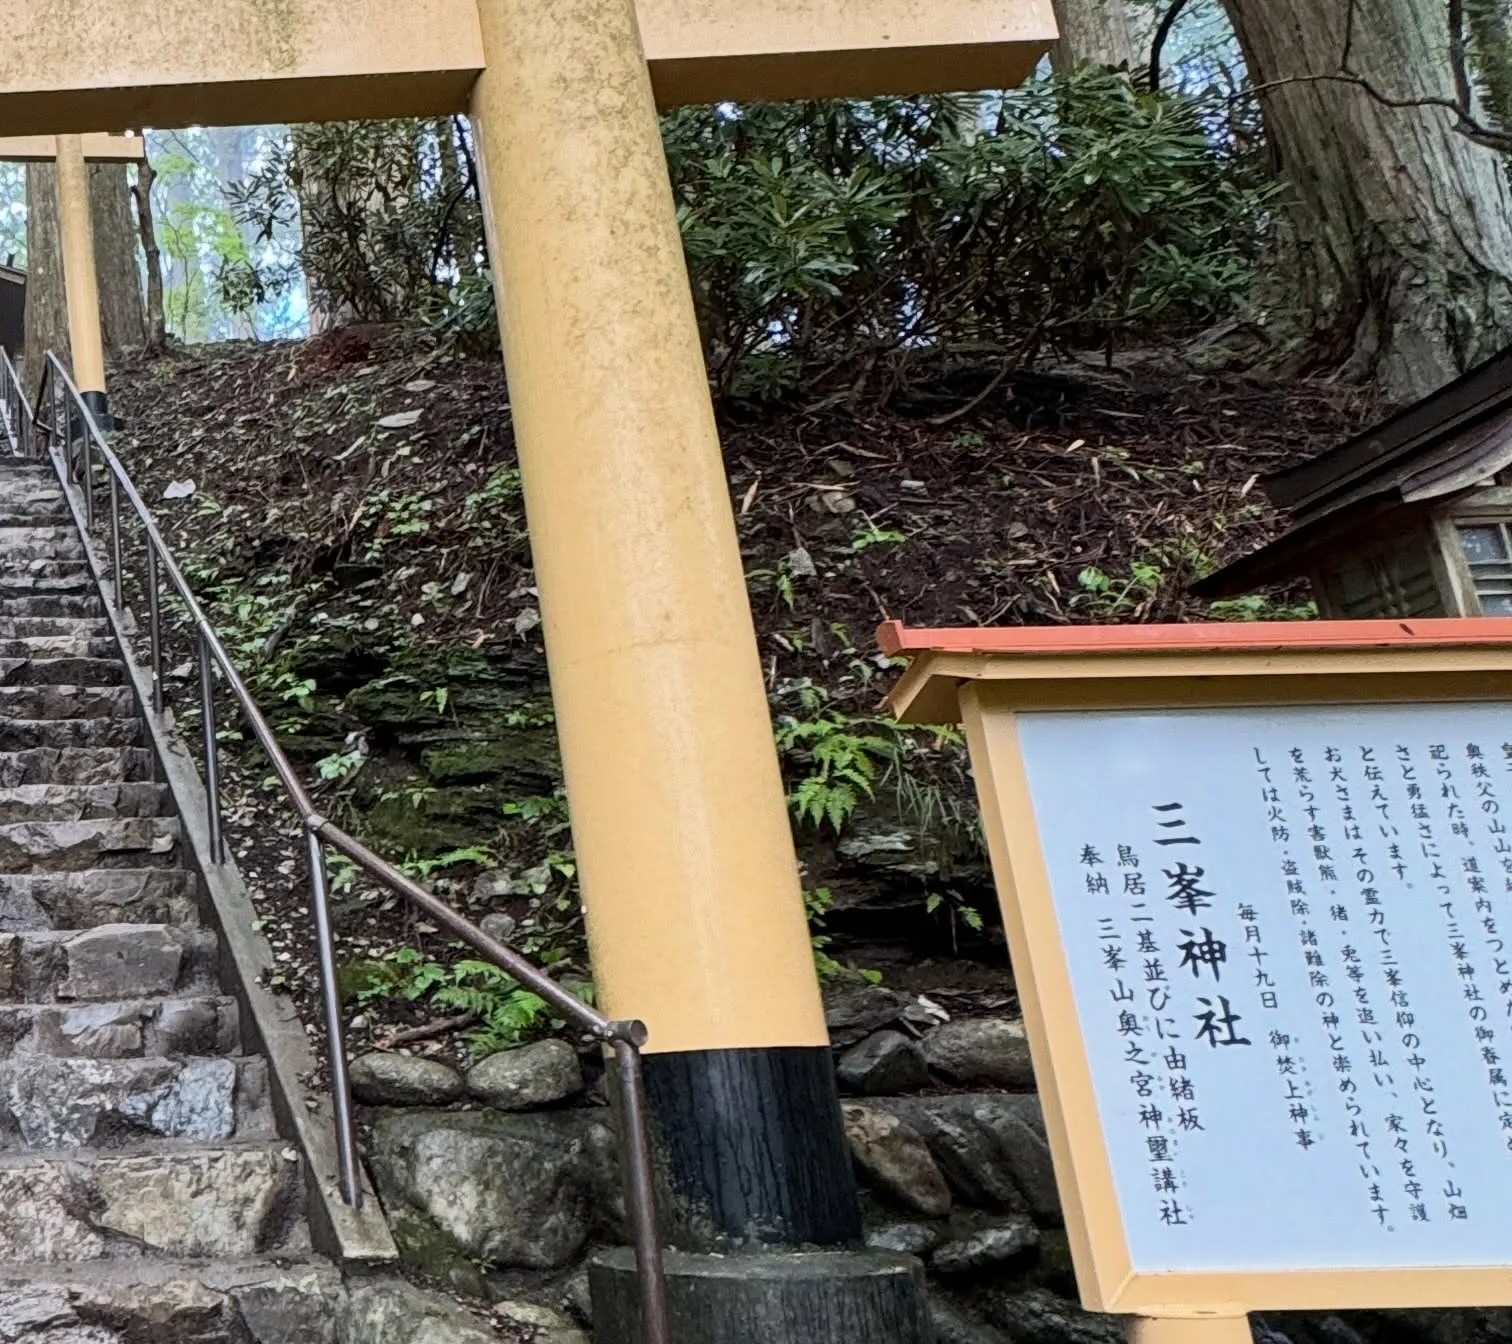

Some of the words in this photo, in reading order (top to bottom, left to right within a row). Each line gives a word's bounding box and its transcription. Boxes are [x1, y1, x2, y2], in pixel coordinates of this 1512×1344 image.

[1079, 843, 1110, 896] 奉納
[1359, 745, 1414, 890] と伝えています。
[1116, 843, 1206, 1132] 鳥居二基並びに由緒板
[1151, 801, 1252, 1048] 三峯神社
[1237, 902, 1279, 1009] 毎月十九日
